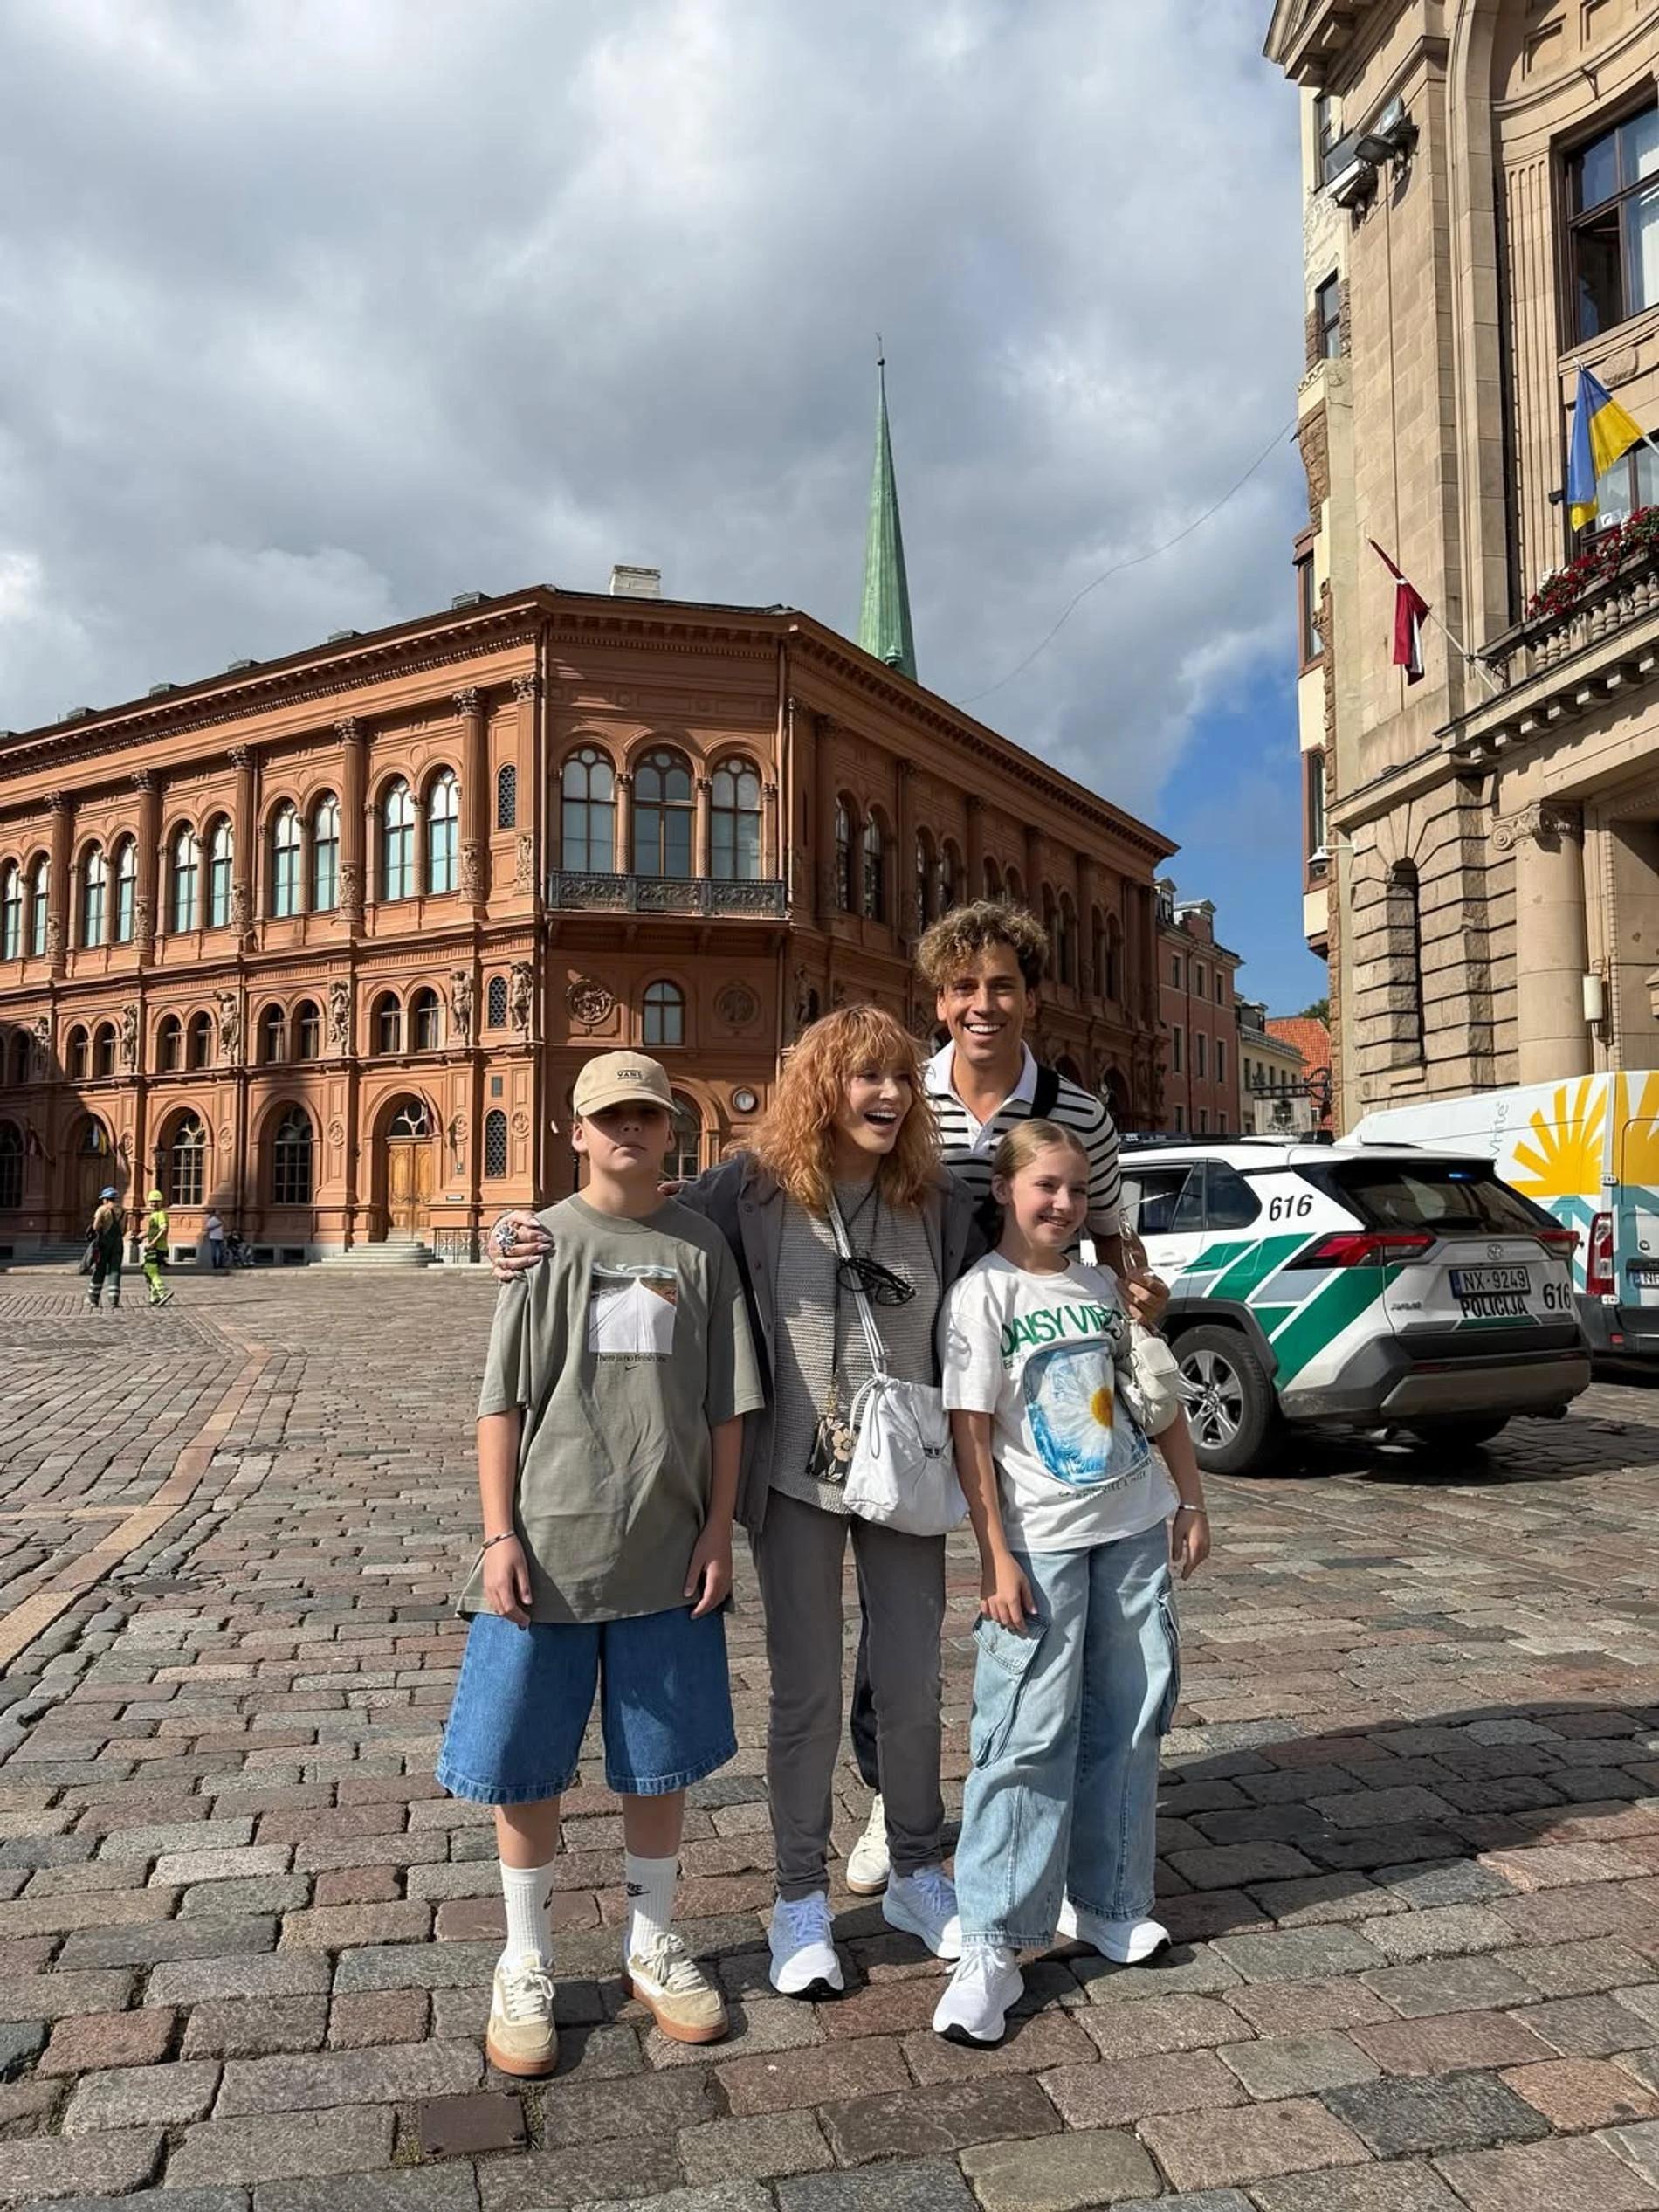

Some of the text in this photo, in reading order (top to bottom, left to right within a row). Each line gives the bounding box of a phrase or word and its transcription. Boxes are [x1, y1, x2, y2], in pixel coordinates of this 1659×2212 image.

[1269, 1194, 1313, 1221] 616
[1463, 1271, 1527, 1292] NX-9249
[1460, 1296, 1529, 1318] POLICIJA
[1543, 1281, 1571, 1310] 616
